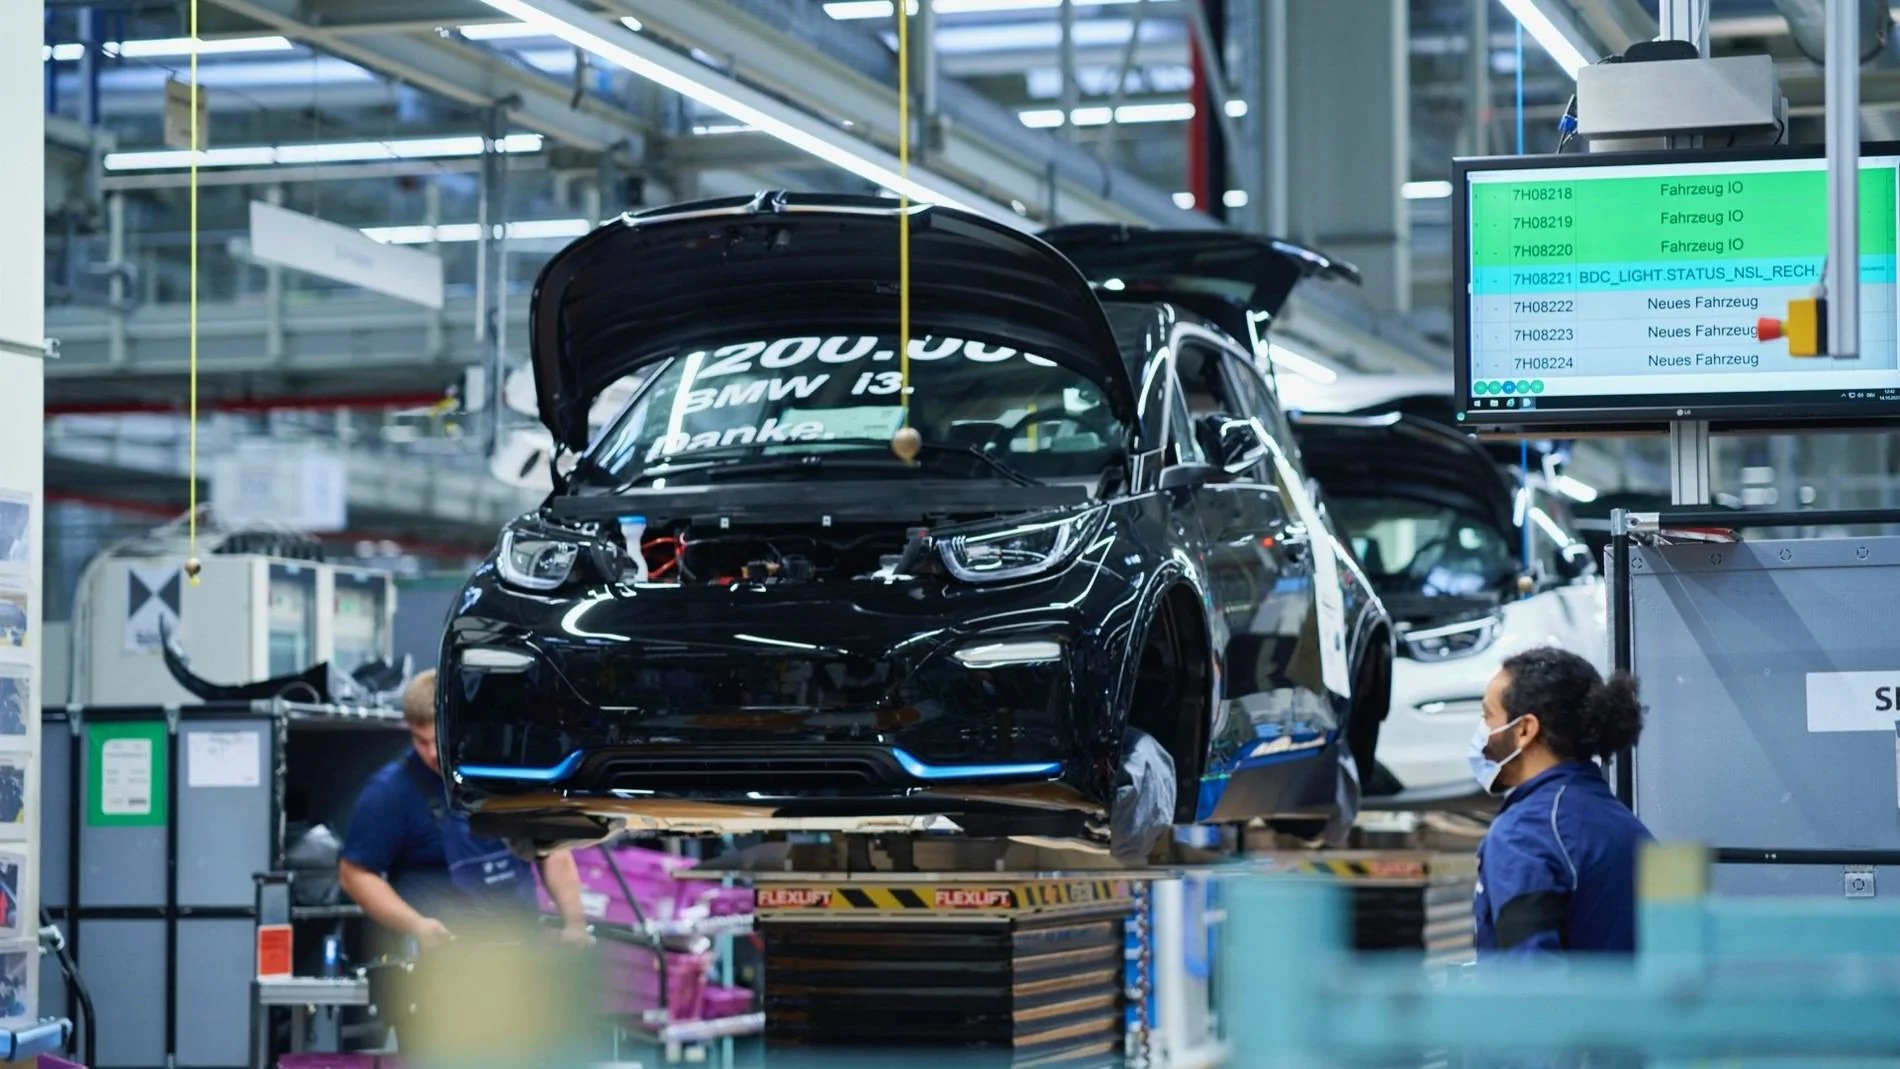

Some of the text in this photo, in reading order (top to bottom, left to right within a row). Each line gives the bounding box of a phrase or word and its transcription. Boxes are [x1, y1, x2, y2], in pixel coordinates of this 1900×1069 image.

[1513, 181, 1743, 201] 7H08218 Fahrzeug IO
[1513, 209, 1744, 229] 7H08219 Fahrzeug IO
[1513, 238, 1744, 257] 7H08220 Fahrzeug IO
[1513, 272, 1572, 285] 7H08221
[1513, 296, 1759, 313] 7H08222 Neues Fahrzeug
[1514, 324, 1758, 342] 7H08223 Neues Fahrzeug
[1514, 353, 1759, 370] 7H08224 Neues Fahrzeug
[683, 374, 830, 415] BMW
[644, 418, 835, 463] Danke.
[758, 889, 1009, 906] FLEXLIFT FLEXLIFT
